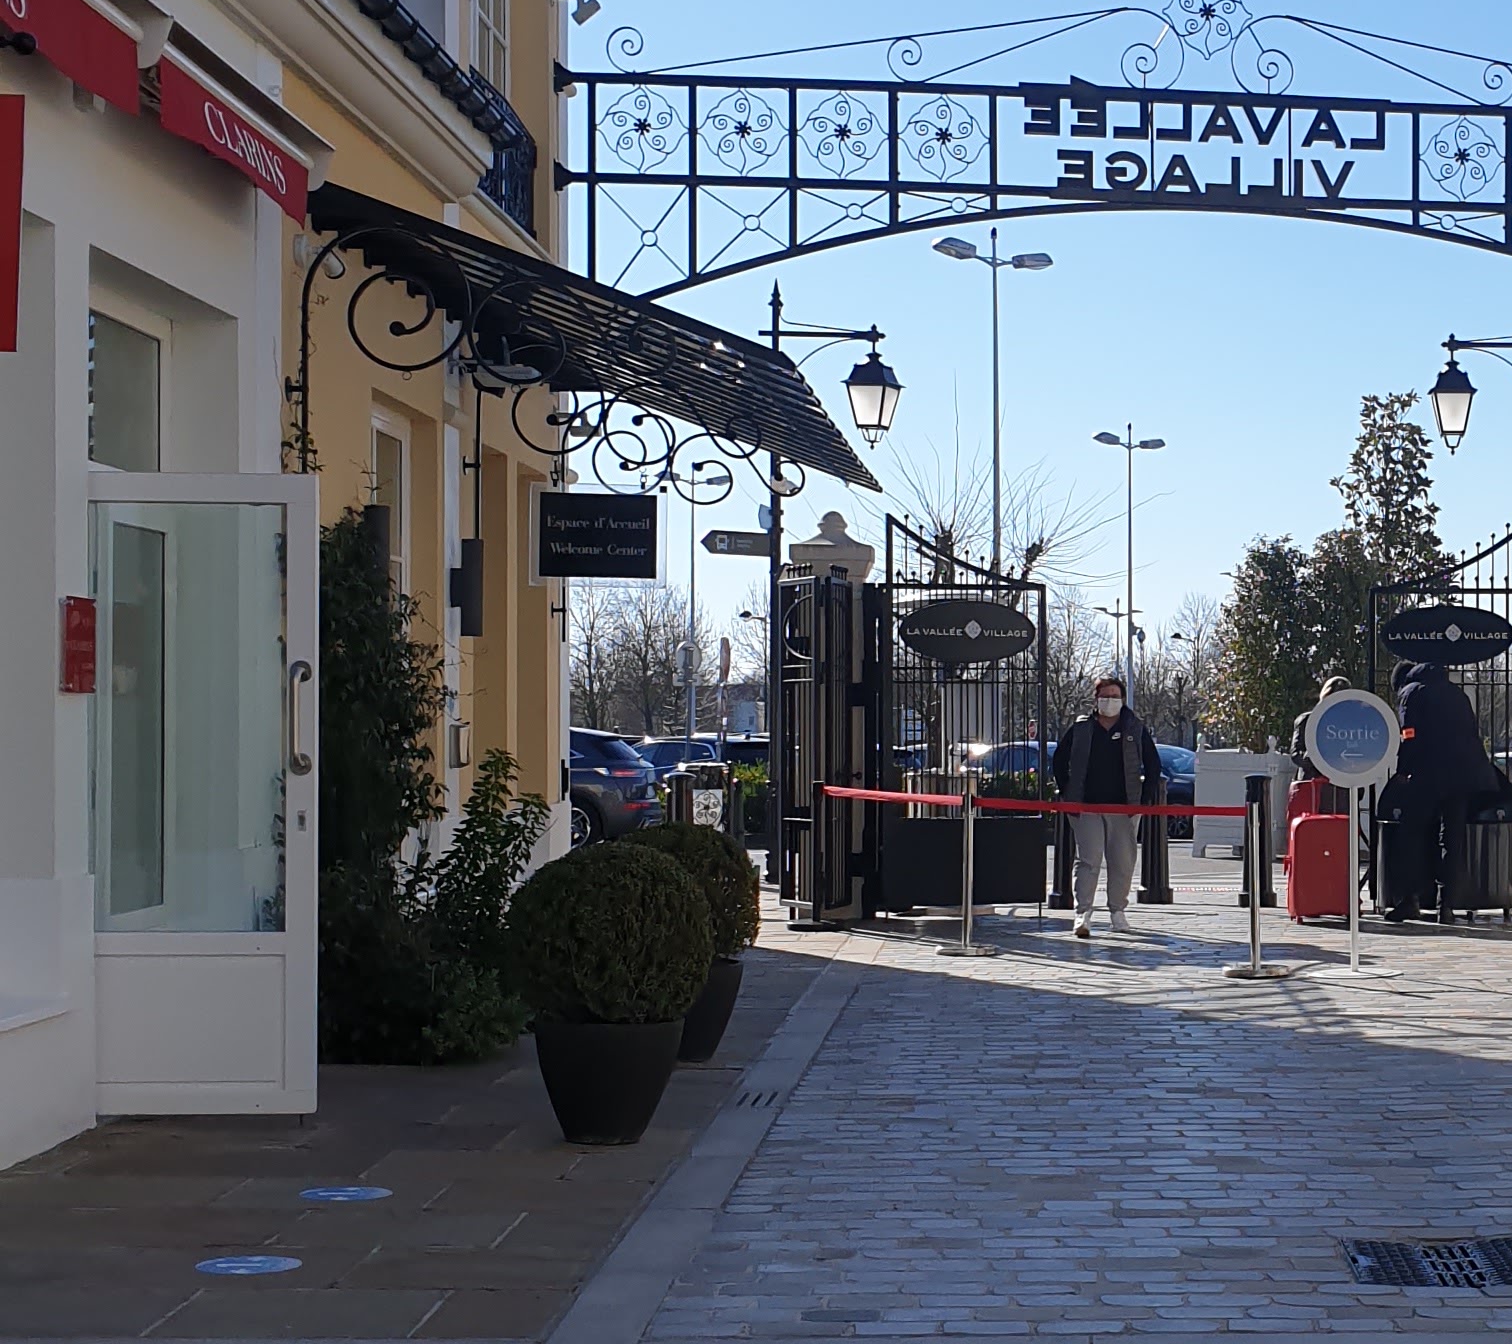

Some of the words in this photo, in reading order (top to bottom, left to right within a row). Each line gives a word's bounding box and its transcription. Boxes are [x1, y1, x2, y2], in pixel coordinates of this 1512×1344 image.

[204, 101, 286, 194] CLARINS
[547, 515, 589, 531] Espace
[594, 518, 650, 530] d'Accueil
[550, 542, 603, 555] Welcome
[607, 544, 647, 556] Center
[906, 627, 920, 635] LA
[922, 627, 963, 636] VALLÉE
[983, 629, 1028, 638] VILLAGE
[1388, 632, 1402, 640] LA
[1403, 631, 1443, 640] VALLÉE
[1463, 632, 1508, 640] VILLAGE
[1326, 724, 1379, 740] Sortie
